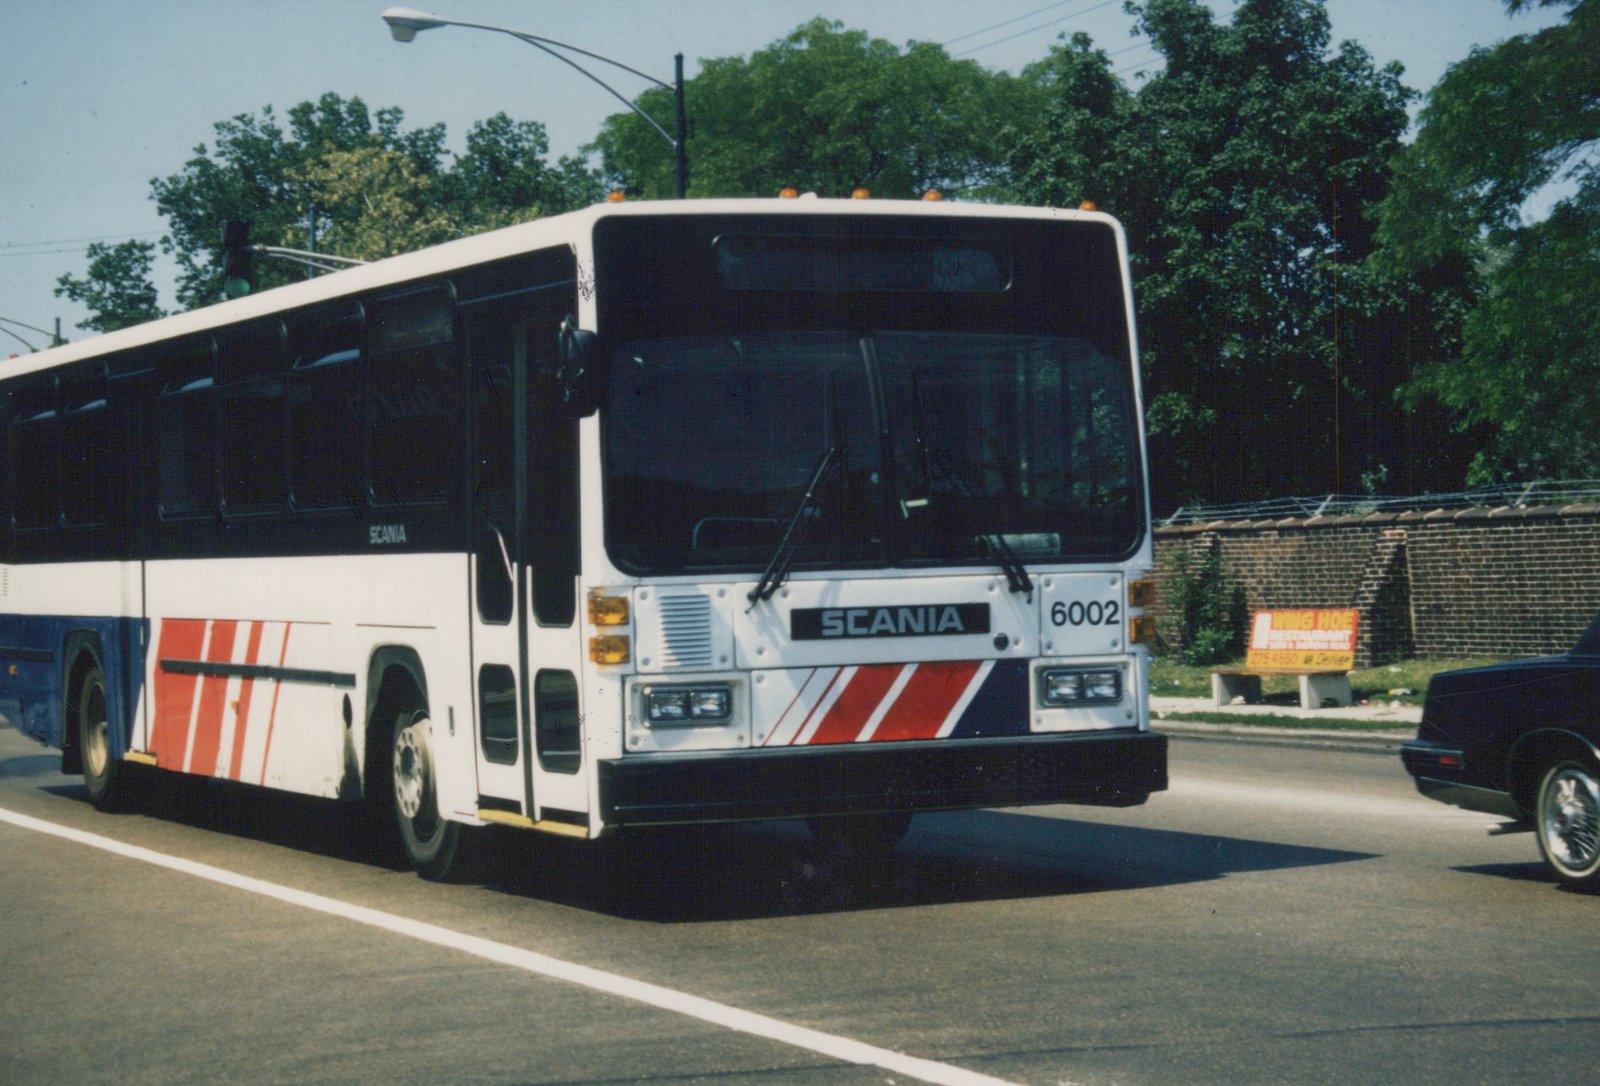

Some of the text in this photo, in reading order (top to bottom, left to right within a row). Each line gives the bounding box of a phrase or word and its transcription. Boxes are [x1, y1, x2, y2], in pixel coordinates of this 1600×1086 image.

[370, 525, 406, 544] SCANIA
[821, 606, 965, 636] SCANIA
[1051, 600, 1120, 627] 6002
[1317, 610, 1354, 630] HOE
